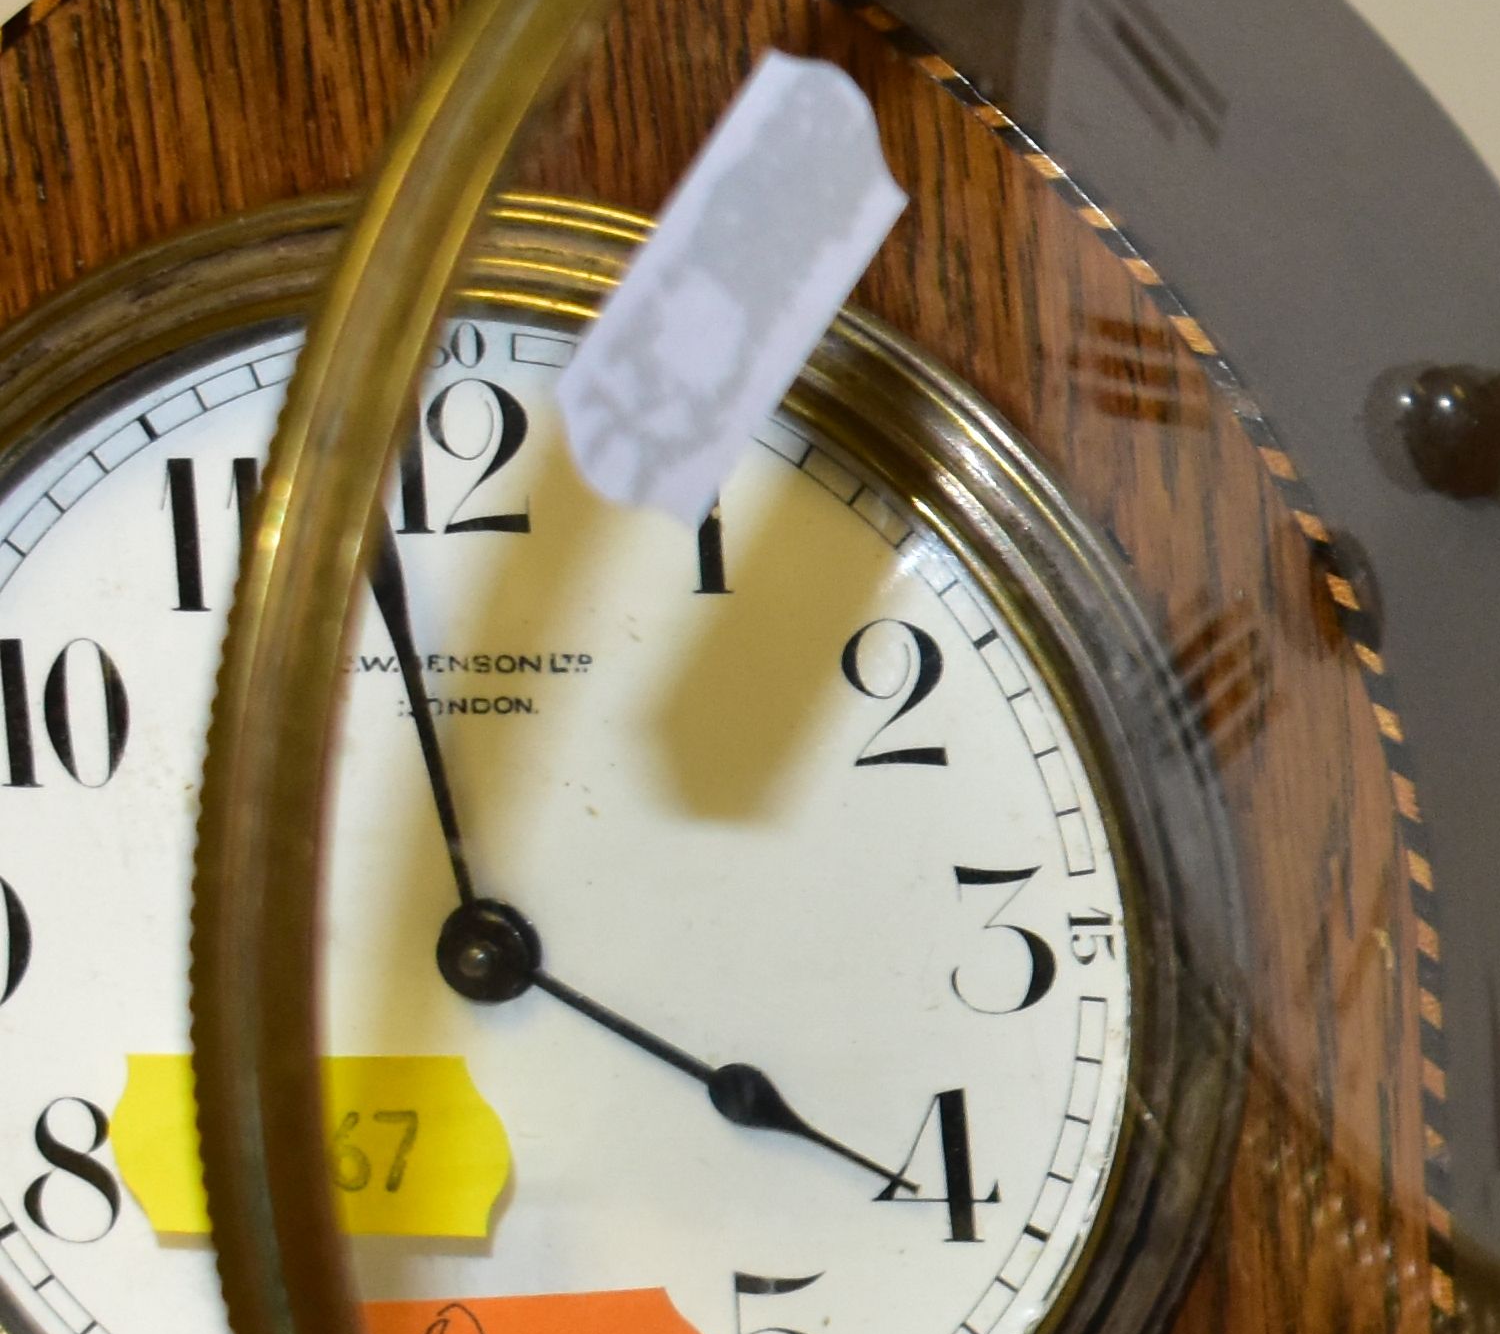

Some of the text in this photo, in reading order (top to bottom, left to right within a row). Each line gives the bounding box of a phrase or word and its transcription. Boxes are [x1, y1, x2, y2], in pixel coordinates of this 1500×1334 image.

[395, 377, 531, 535] 12
[841, 618, 948, 768] 2
[951, 865, 1057, 1016] 3
[1067, 907, 1115, 966] 15
[24, 1096, 121, 1243] 8
[872, 1087, 1000, 1243] 4
